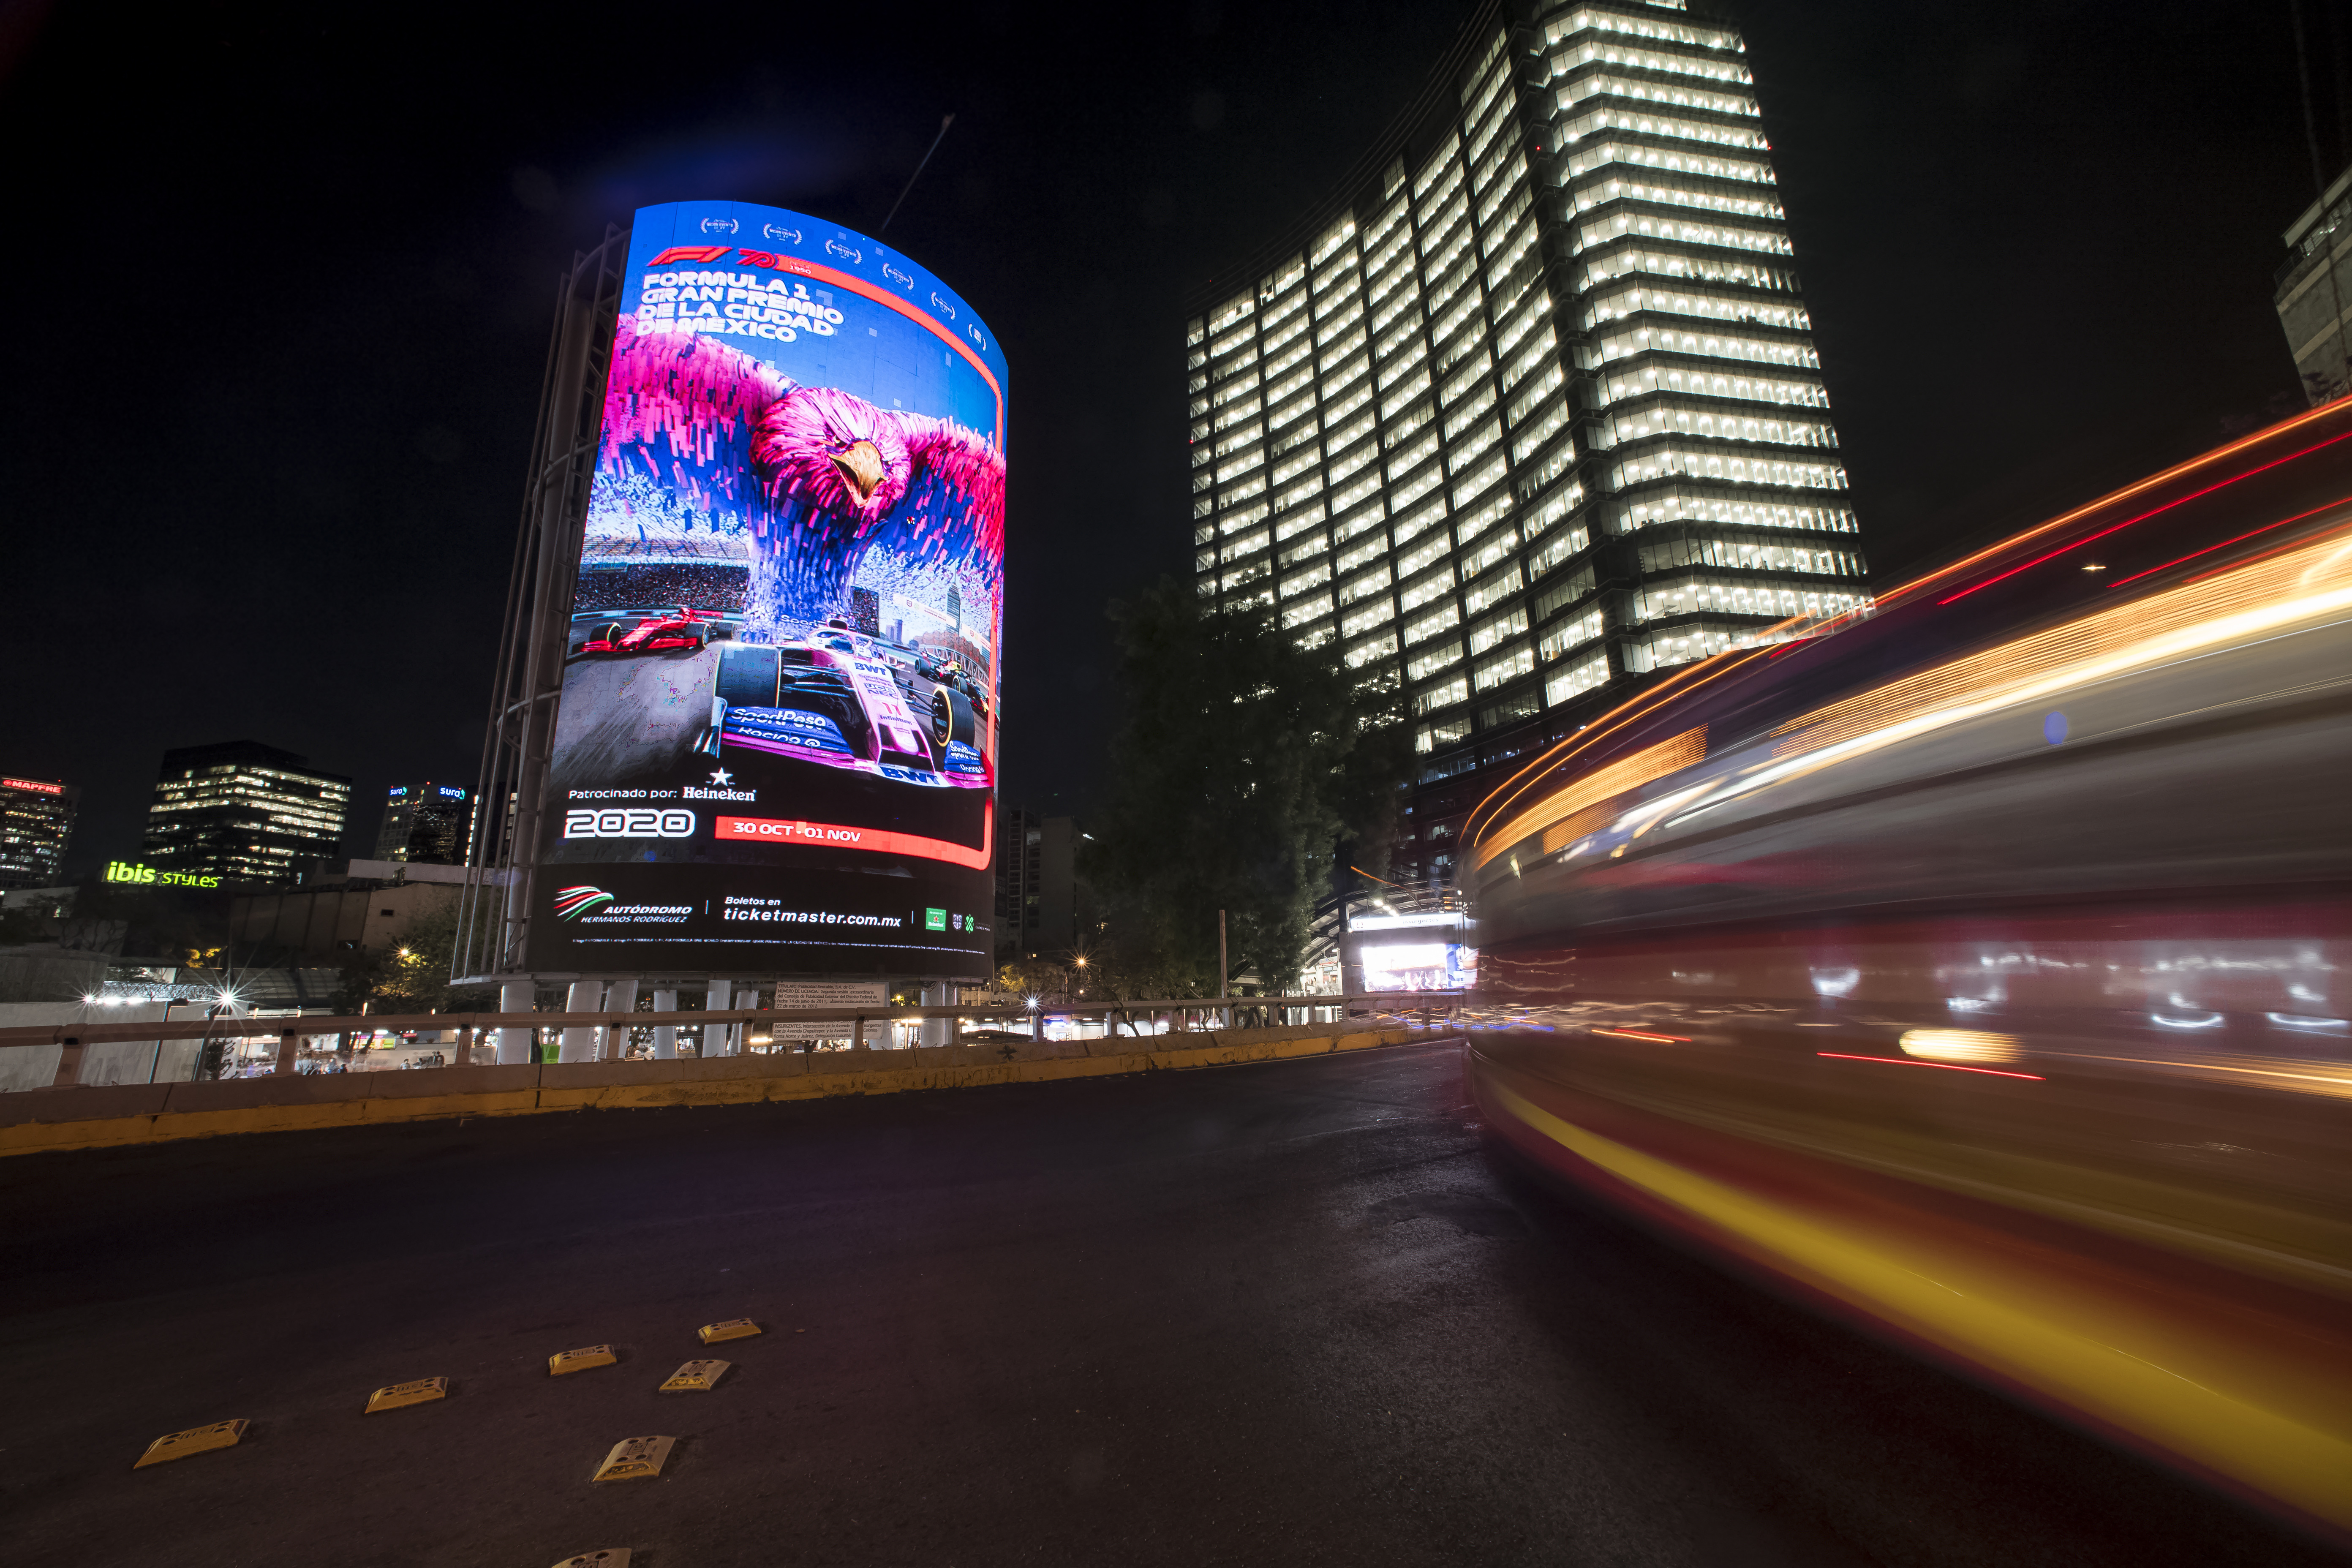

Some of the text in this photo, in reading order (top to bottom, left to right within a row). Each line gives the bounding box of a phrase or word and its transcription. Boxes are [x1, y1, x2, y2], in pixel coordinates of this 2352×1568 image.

[644, 272, 810, 300] FORMULA 1
[642, 286, 844, 324] GRAN PREMIO
[637, 318, 673, 336] DE
[639, 302, 835, 336] DE LA CIUDAD
[855, 662, 886, 675] BWT
[882, 702, 902, 716] 11
[880, 766, 940, 785] BWT
[12, 781, 61, 793] MAPFRE
[440, 787, 460, 797] sura
[569, 787, 757, 802] Patrocinado por: Heineken
[564, 809, 696, 838] 2020
[733, 822, 861, 842] 30 OCT 01 NOV
[107, 861, 156, 882] ibis
[725, 896, 765, 905] Boletos
[724, 908, 901, 927] ticketmaster.com.mx
